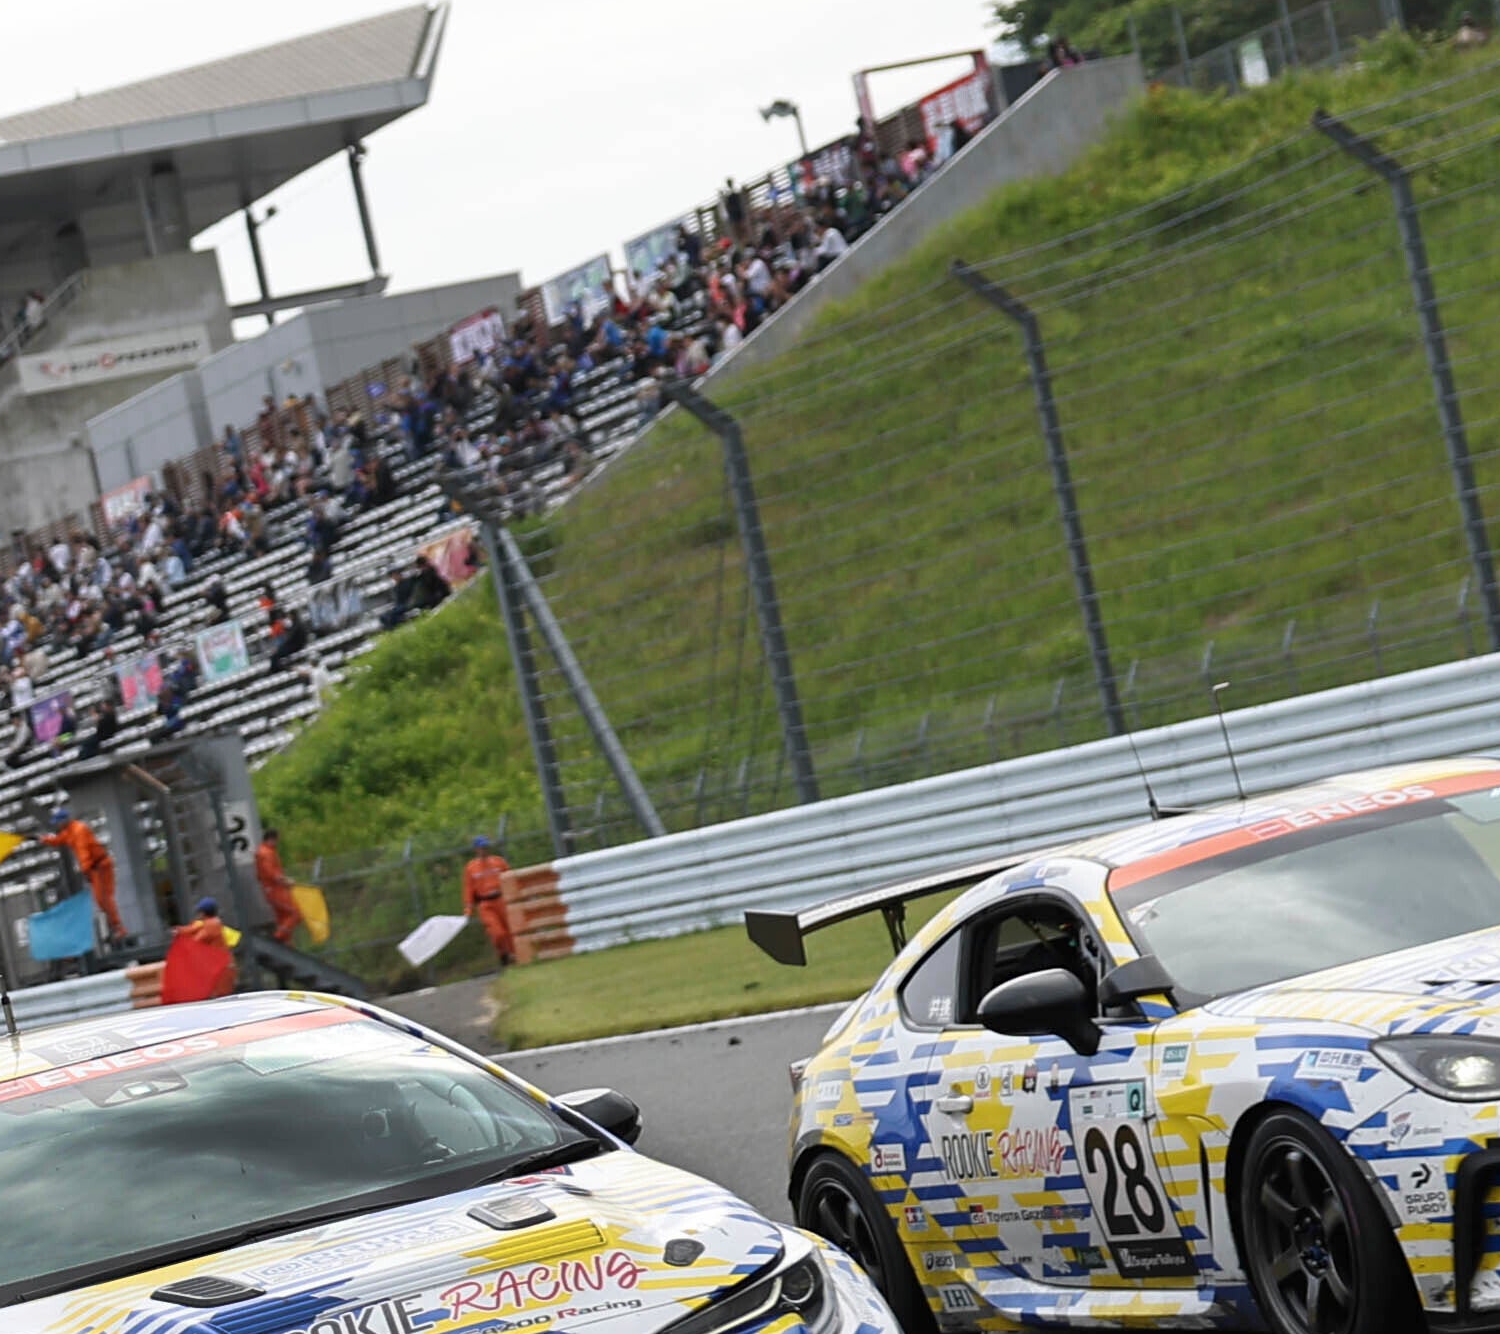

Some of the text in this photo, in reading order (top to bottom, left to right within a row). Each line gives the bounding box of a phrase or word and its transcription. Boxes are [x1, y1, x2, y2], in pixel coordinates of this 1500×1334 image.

[1288, 784, 1437, 828] ENEOS
[38, 1036, 218, 1088] ENEOS
[941, 1125, 1066, 1180] ROOKIE RACING
[1084, 1124, 1166, 1236] 28
[439, 1251, 648, 1323] RACING
[556, 1297, 643, 1322] Racing
[943, 1287, 975, 1308] IHI
